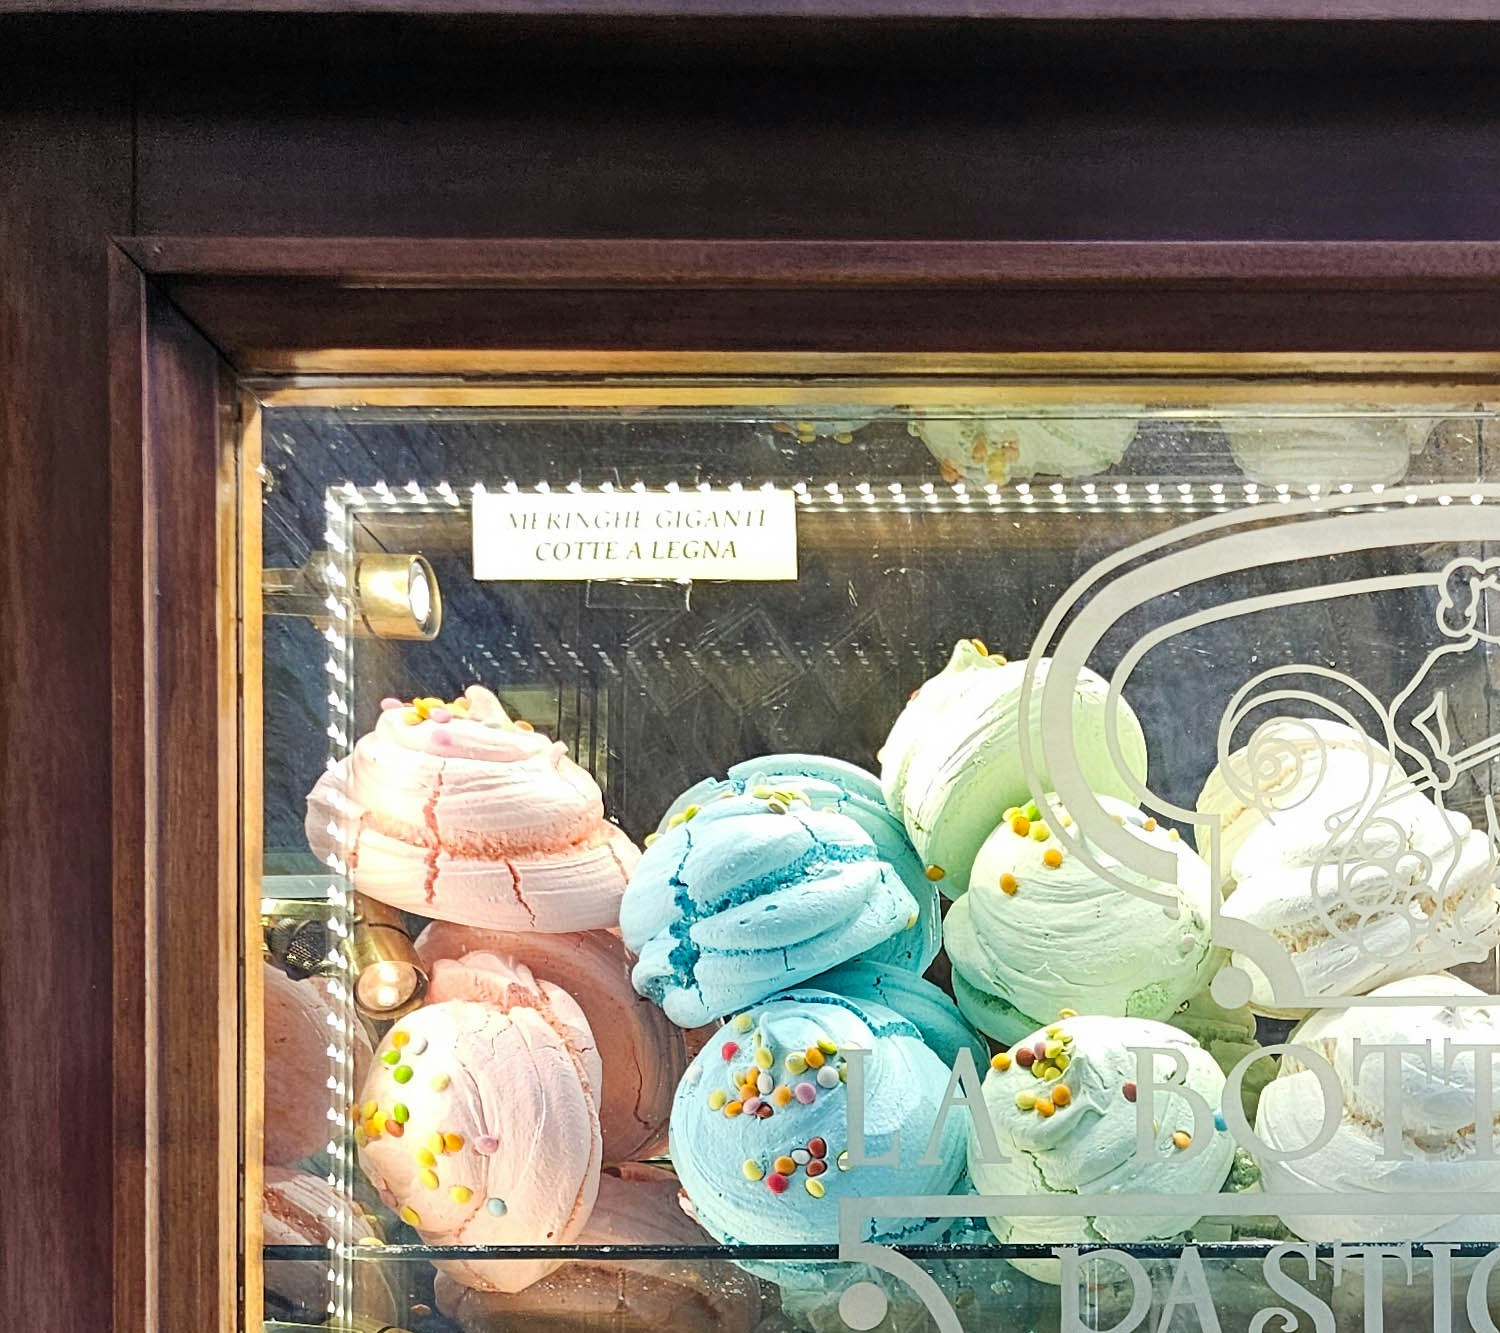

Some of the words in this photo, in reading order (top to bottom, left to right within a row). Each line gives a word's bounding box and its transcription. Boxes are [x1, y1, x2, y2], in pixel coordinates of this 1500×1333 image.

[509, 510, 641, 530] MERINGHE
[655, 509, 768, 529] GIGANTI
[535, 541, 619, 562] COTTE
[626, 541, 642, 560] A
[651, 539, 738, 559] LEGNA
[847, 1046, 1010, 1164] LA
